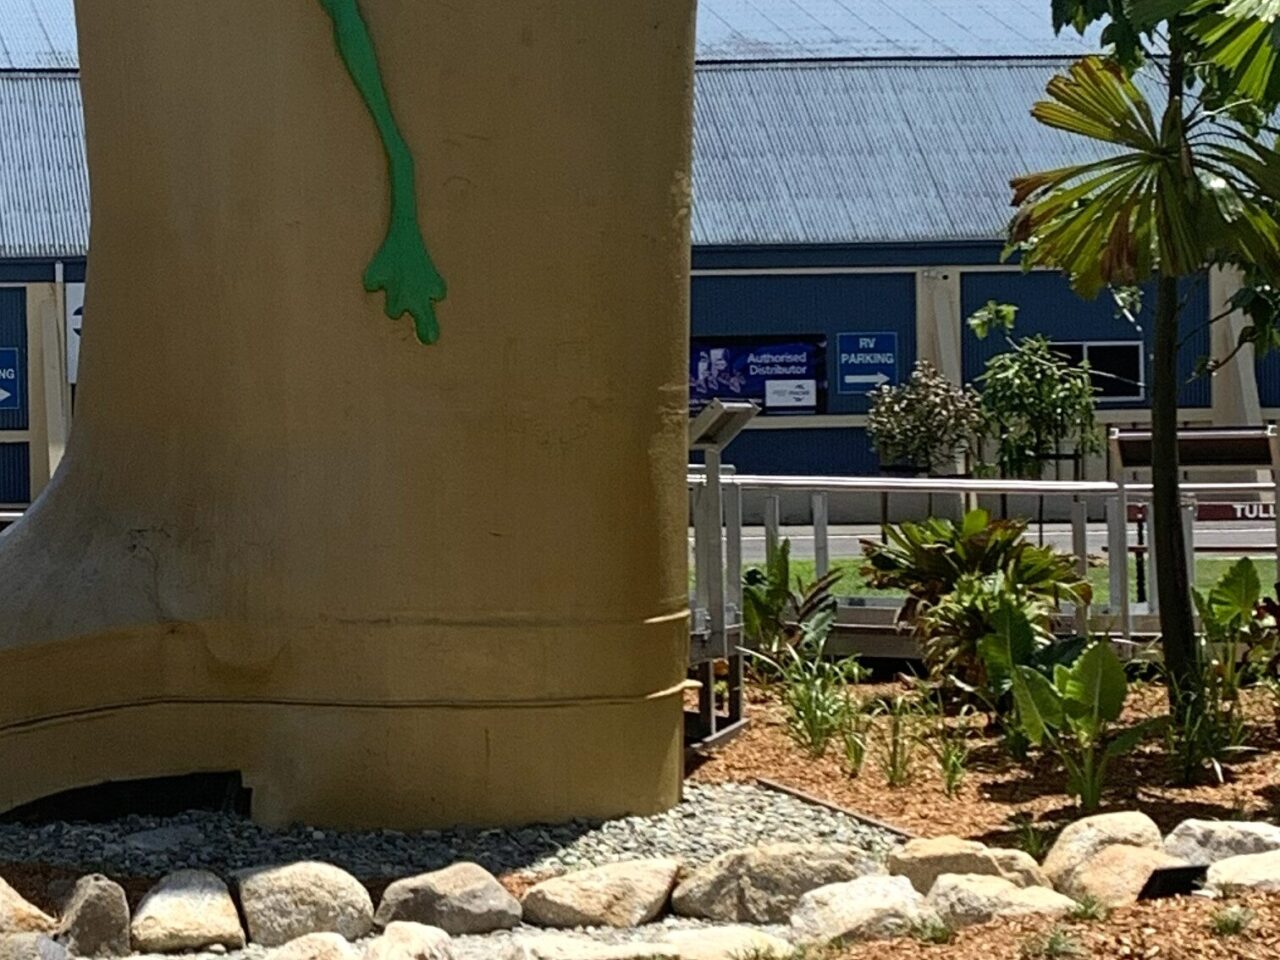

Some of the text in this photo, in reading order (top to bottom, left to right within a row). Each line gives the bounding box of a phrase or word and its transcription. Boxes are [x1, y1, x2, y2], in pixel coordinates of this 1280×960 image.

[859, 337, 876, 349] RV
[747, 351, 807, 363] Authorised
[841, 352, 895, 364] PARKING
[749, 364, 807, 376] Distributor
